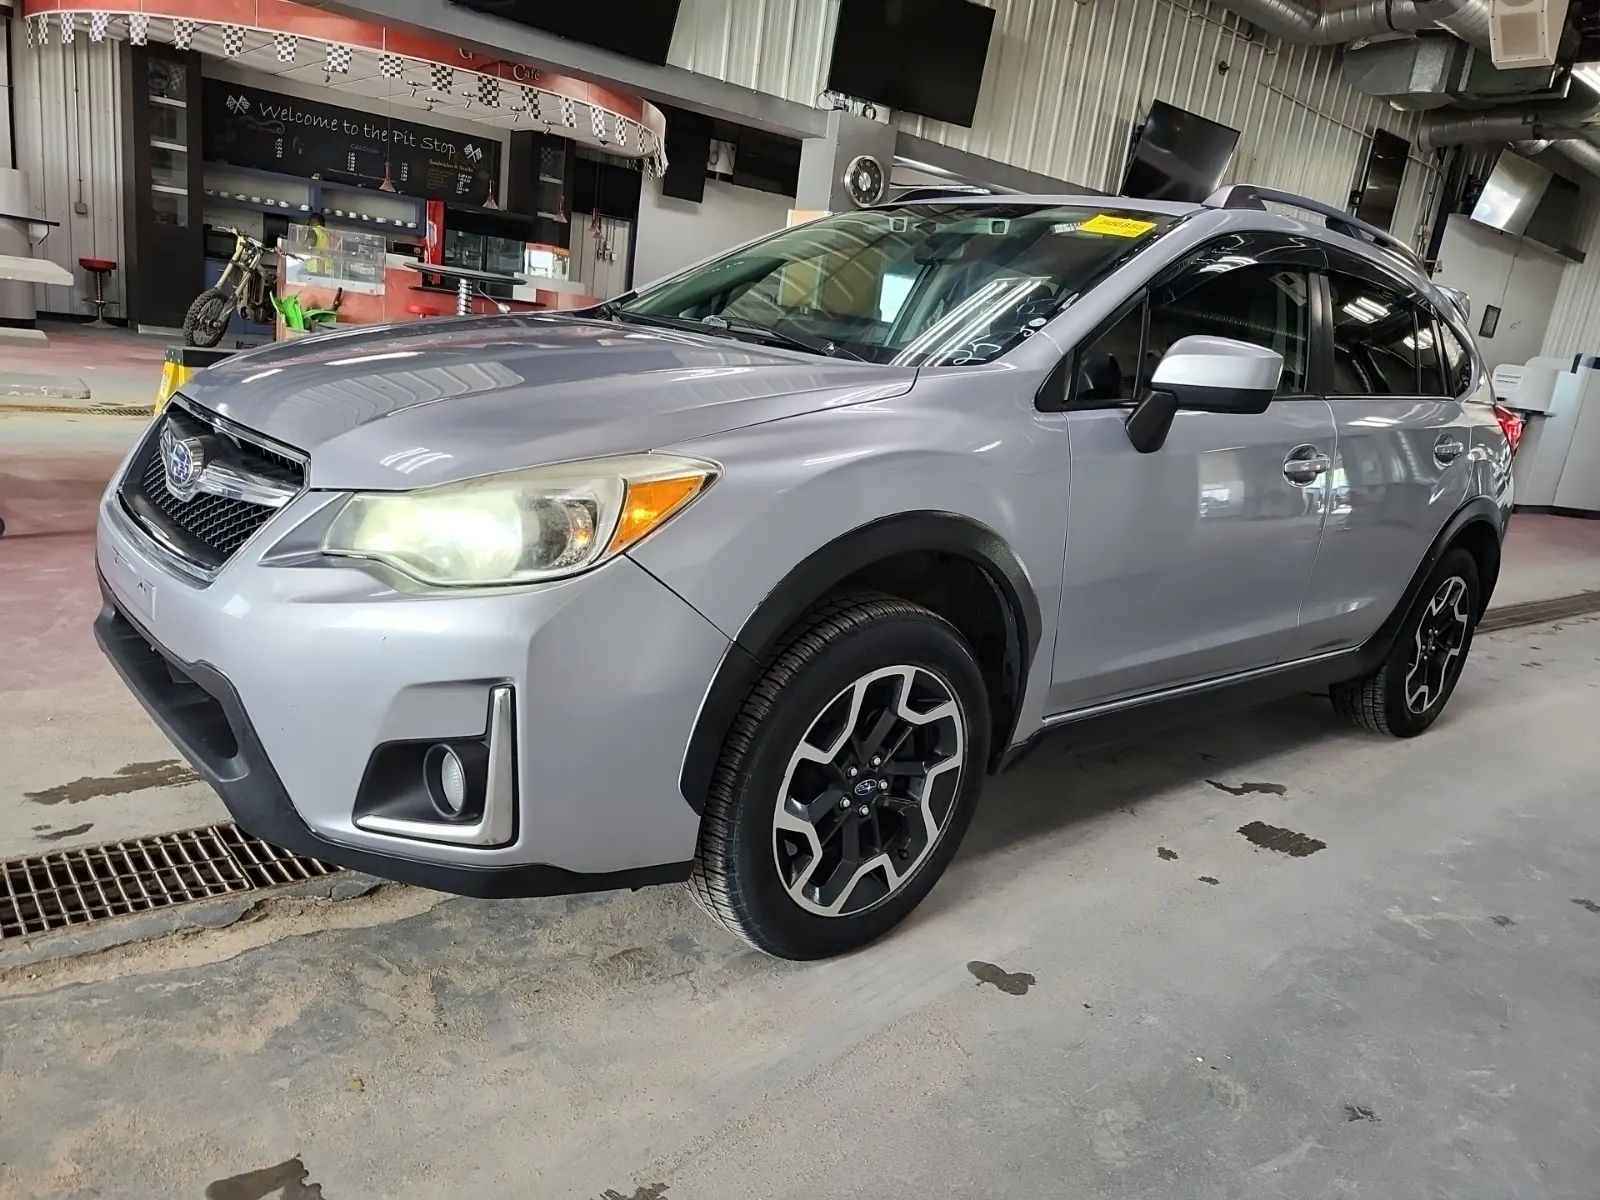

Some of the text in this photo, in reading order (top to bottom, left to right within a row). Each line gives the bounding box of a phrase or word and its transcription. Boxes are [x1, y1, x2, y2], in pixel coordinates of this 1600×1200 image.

[260, 103, 456, 161] Welcome to the Pit Stop
